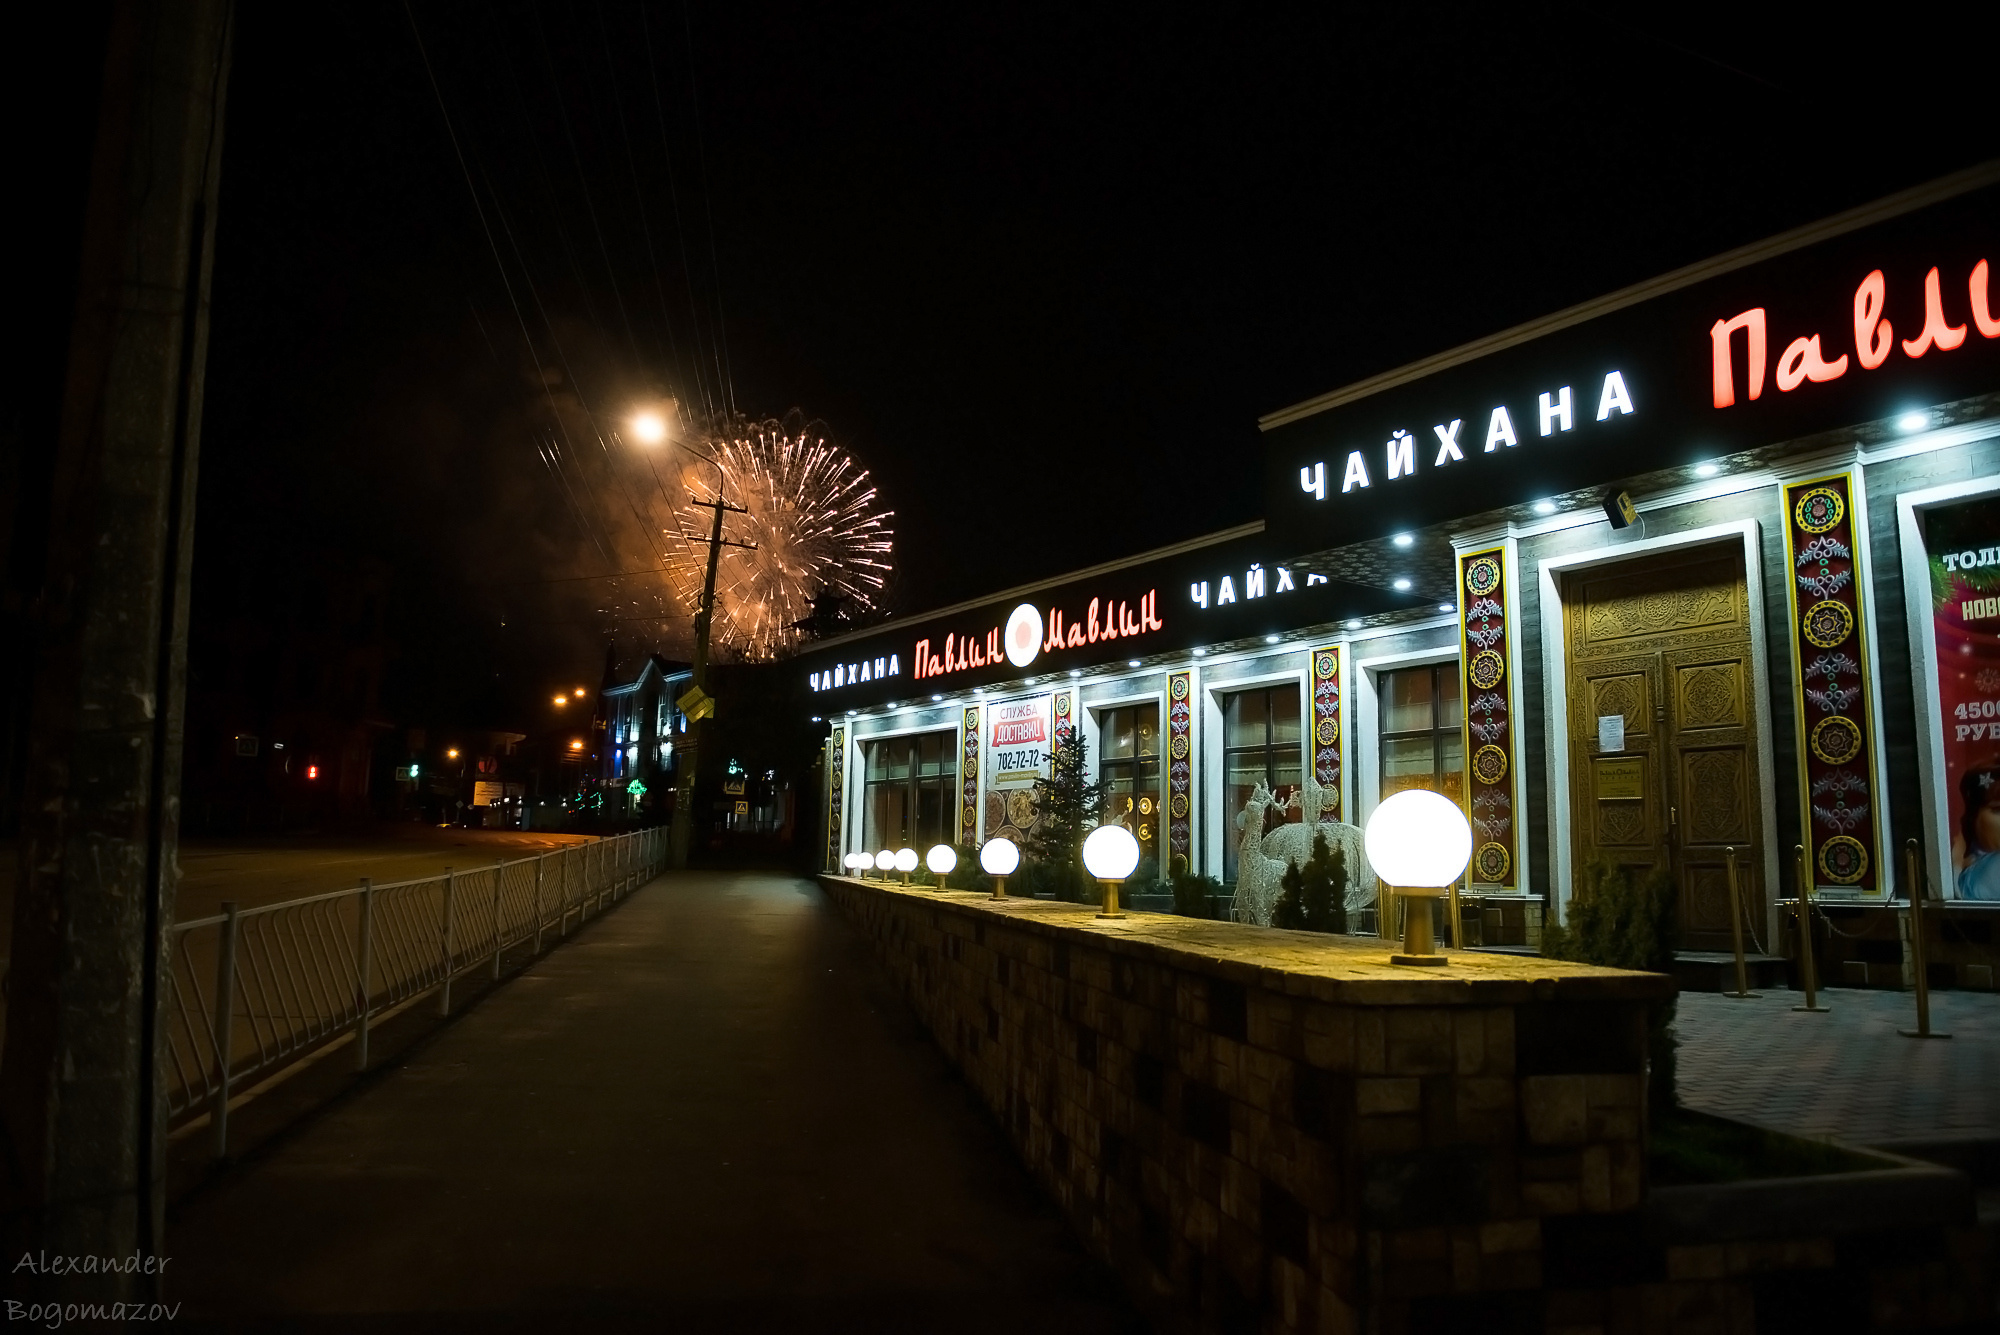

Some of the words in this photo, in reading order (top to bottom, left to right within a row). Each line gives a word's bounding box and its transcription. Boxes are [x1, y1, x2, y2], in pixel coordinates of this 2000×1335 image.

[1299, 369, 1635, 501] ЧАЙХАНА
[1942, 546, 2000, 572] ТОЛ
[1961, 596, 2000, 621] НОВ
[809, 653, 900, 692] ЧАЙХАНА
[914, 626, 1004, 680] Павлин
[1043, 588, 1163, 653] Мавлин
[1000, 704, 1038, 720] СЛУЖБА
[996, 719, 1041, 744] ДОСТАВКИ
[997, 749, 1040, 771] 702-72-72
